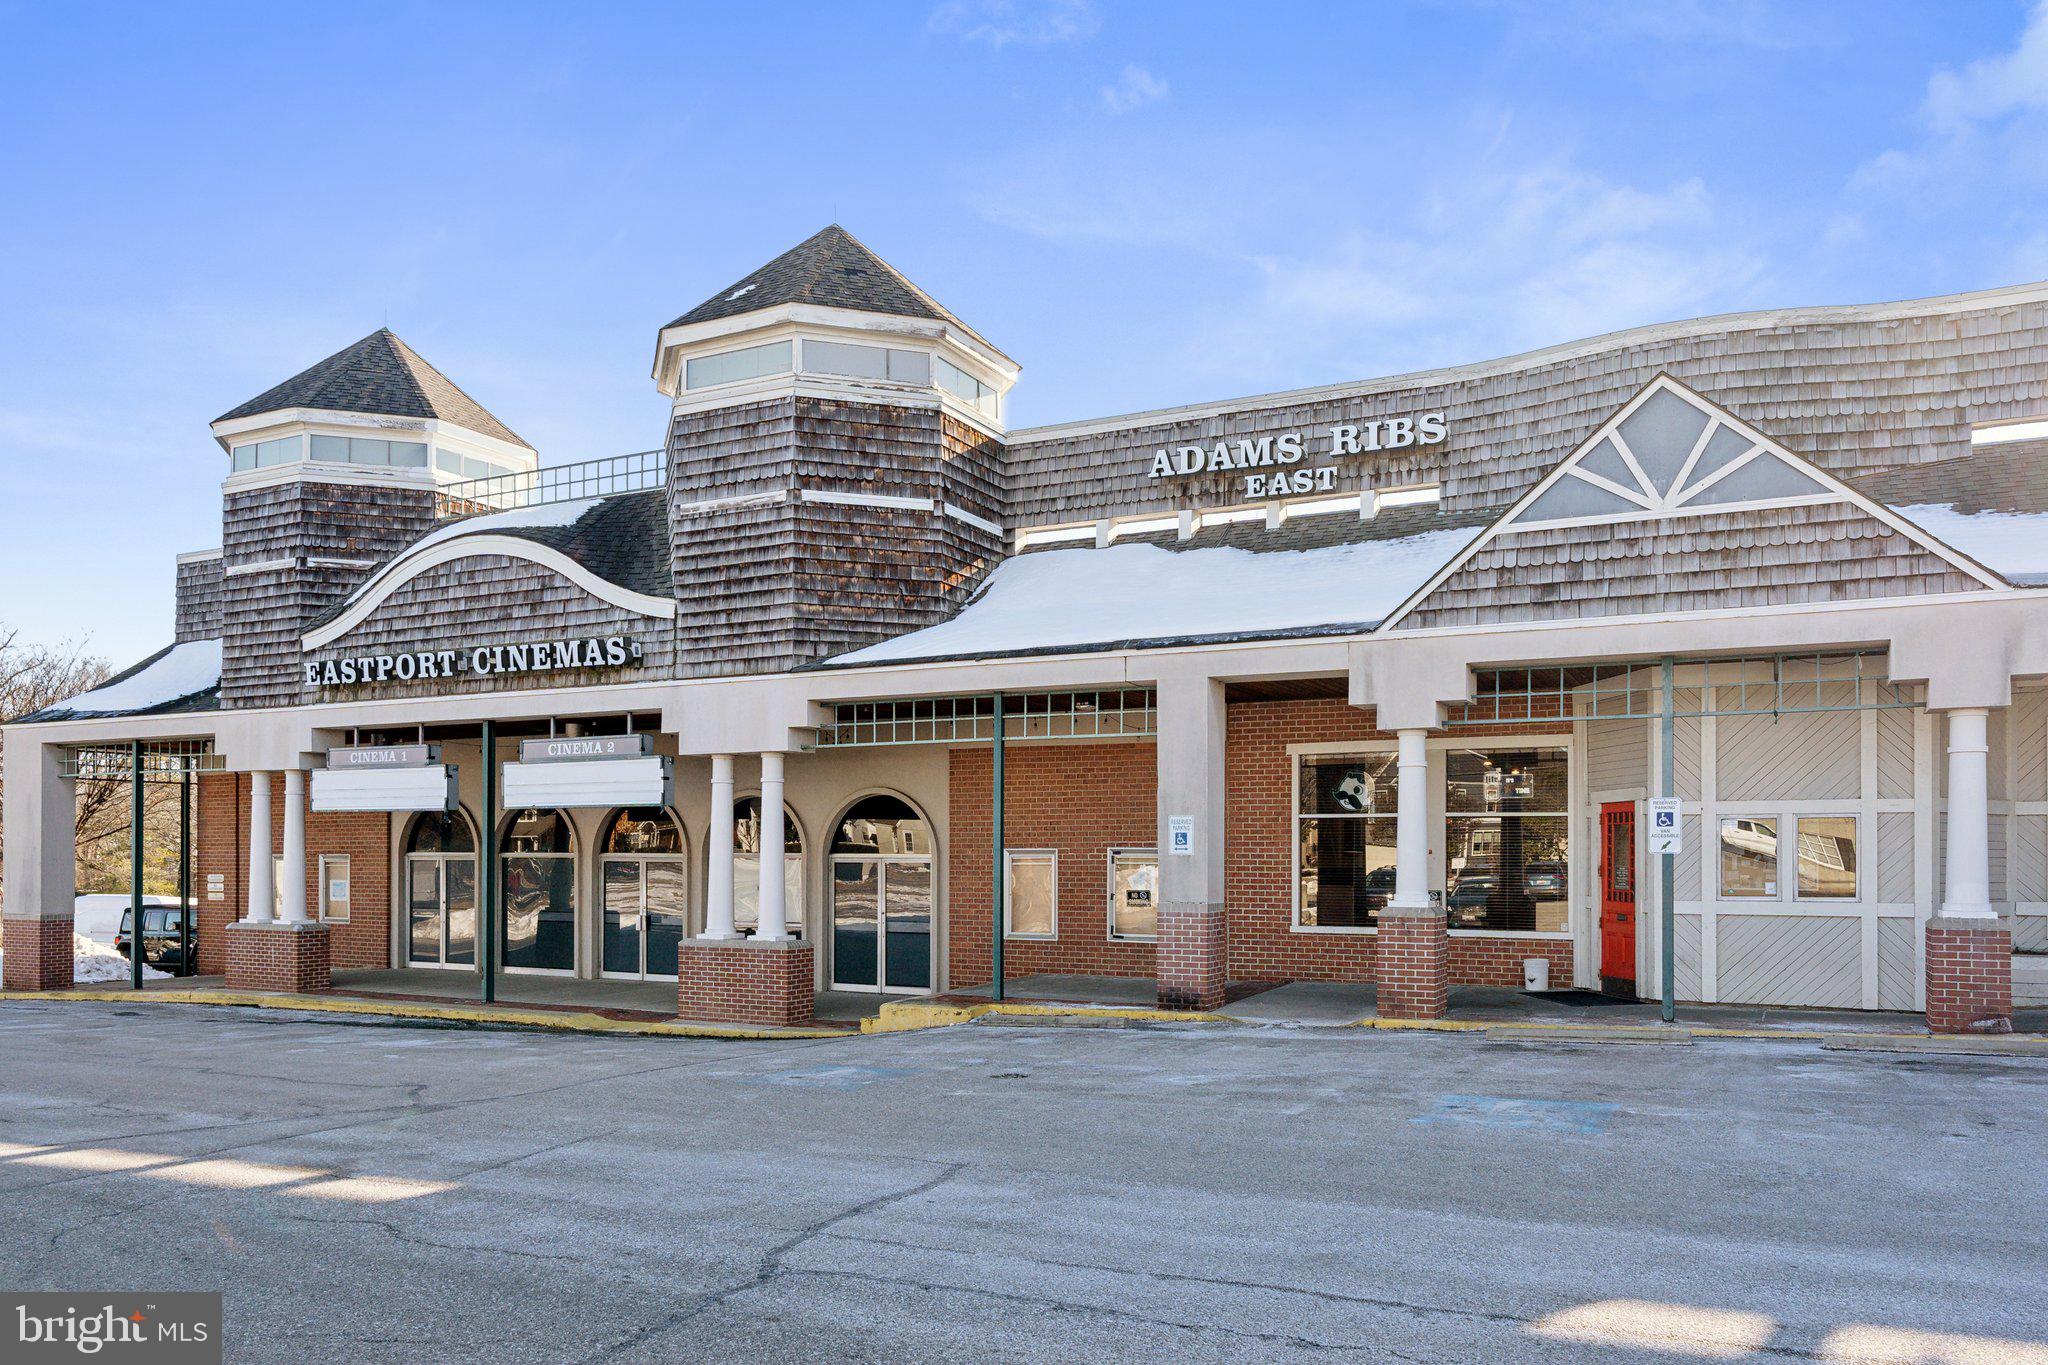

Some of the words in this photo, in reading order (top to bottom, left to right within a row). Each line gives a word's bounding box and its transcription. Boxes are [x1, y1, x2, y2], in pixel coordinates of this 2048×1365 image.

[1148, 433, 1303, 478] ADAMS
[1329, 411, 1448, 457] RIBS
[1244, 466, 1338, 499] EAST
[303, 650, 456, 686] EASTPORT
[472, 636, 627, 675] CINEMAS
[350, 751, 396, 763] CINEMA
[401, 751, 407, 762] 1
[547, 742, 603, 756] CINEMA
[606, 740, 616, 753] 2
